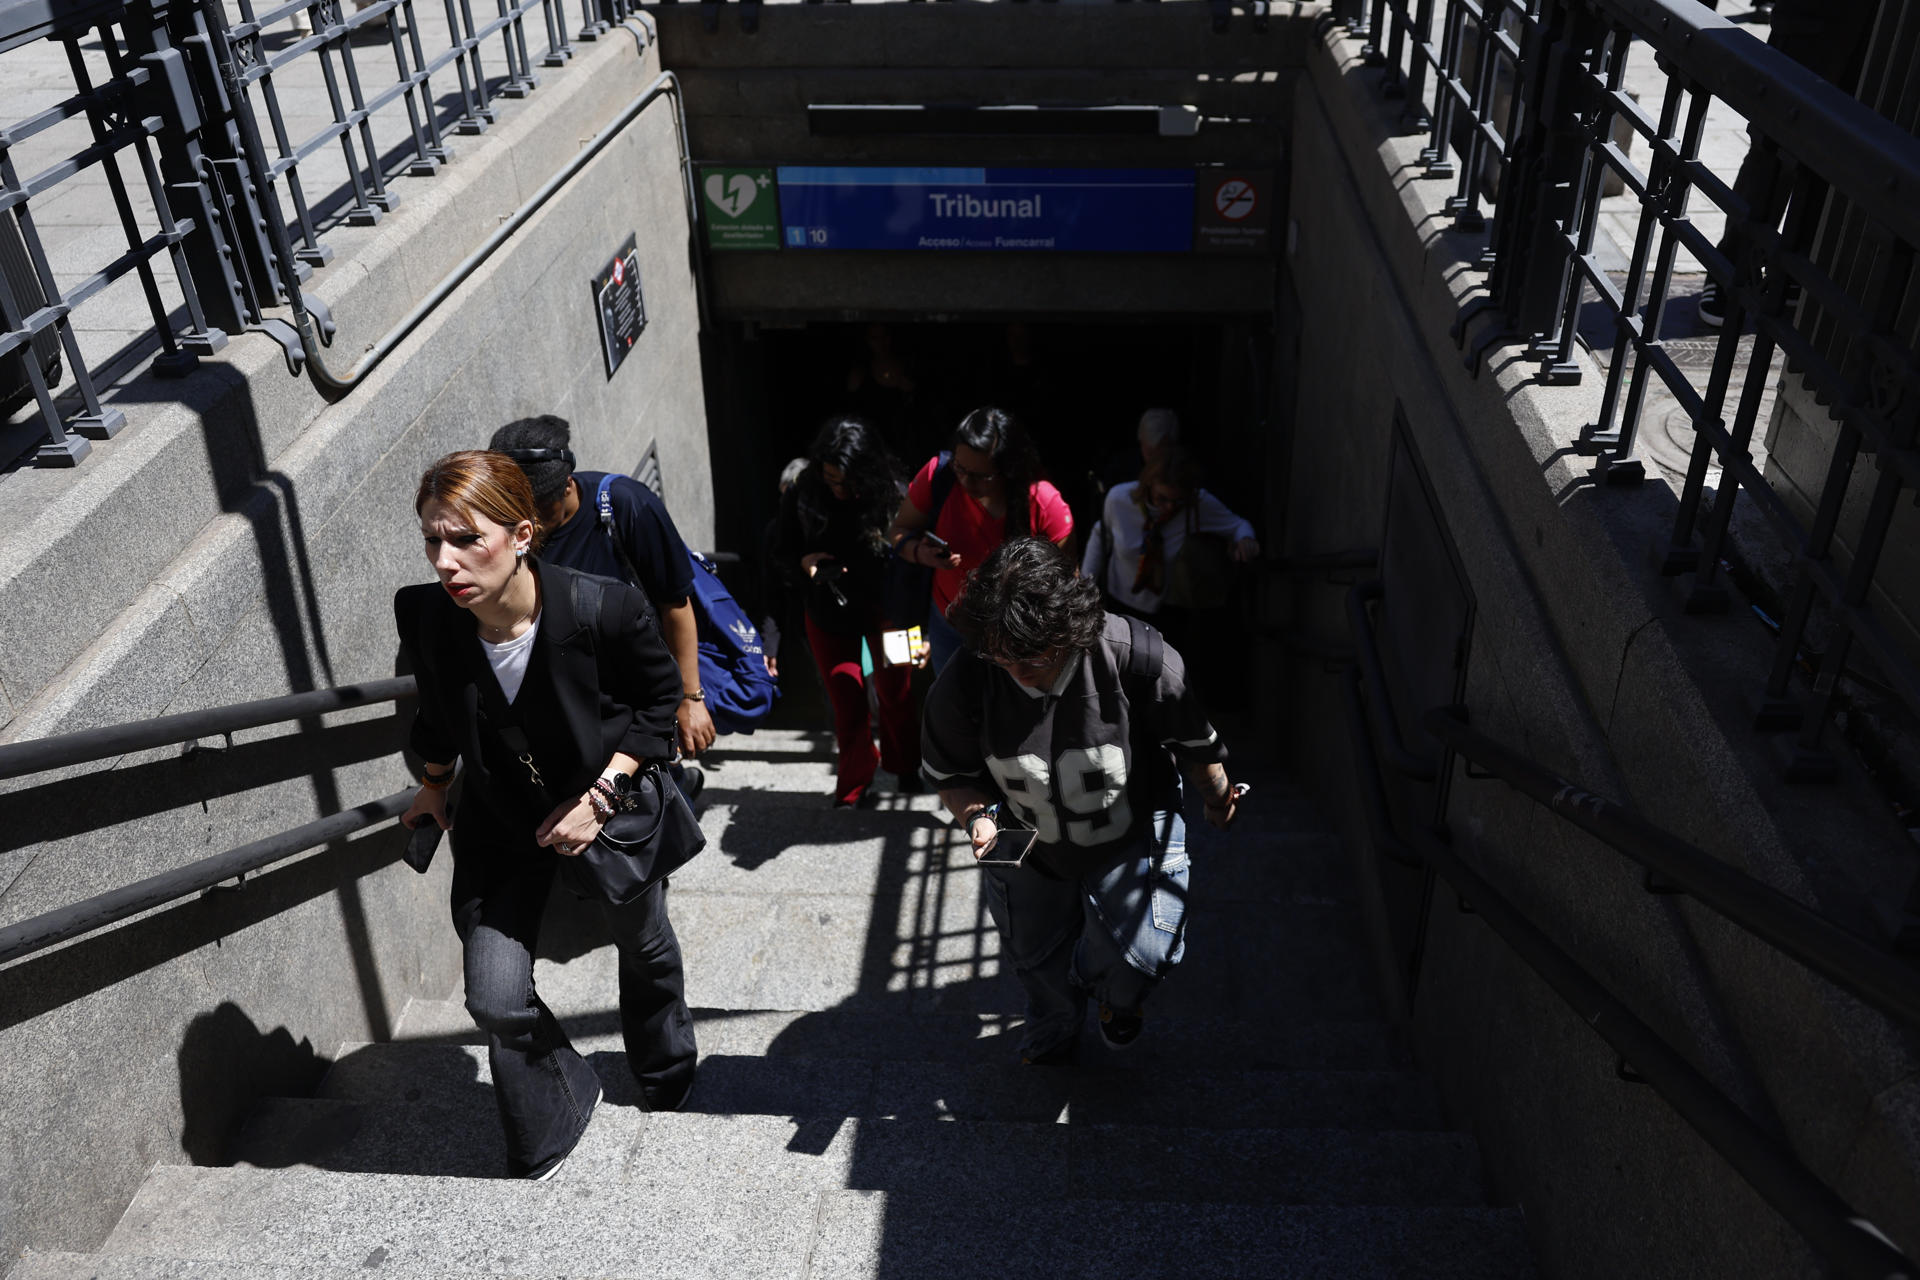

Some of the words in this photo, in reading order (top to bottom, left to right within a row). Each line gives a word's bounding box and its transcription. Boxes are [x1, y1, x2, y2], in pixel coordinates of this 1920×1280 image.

[928, 193, 1042, 217] Tribunal
[792, 229, 801, 243] 1
[808, 229, 828, 243] 10
[994, 235, 1056, 248] Fuencarral
[984, 743, 1134, 848] 89
